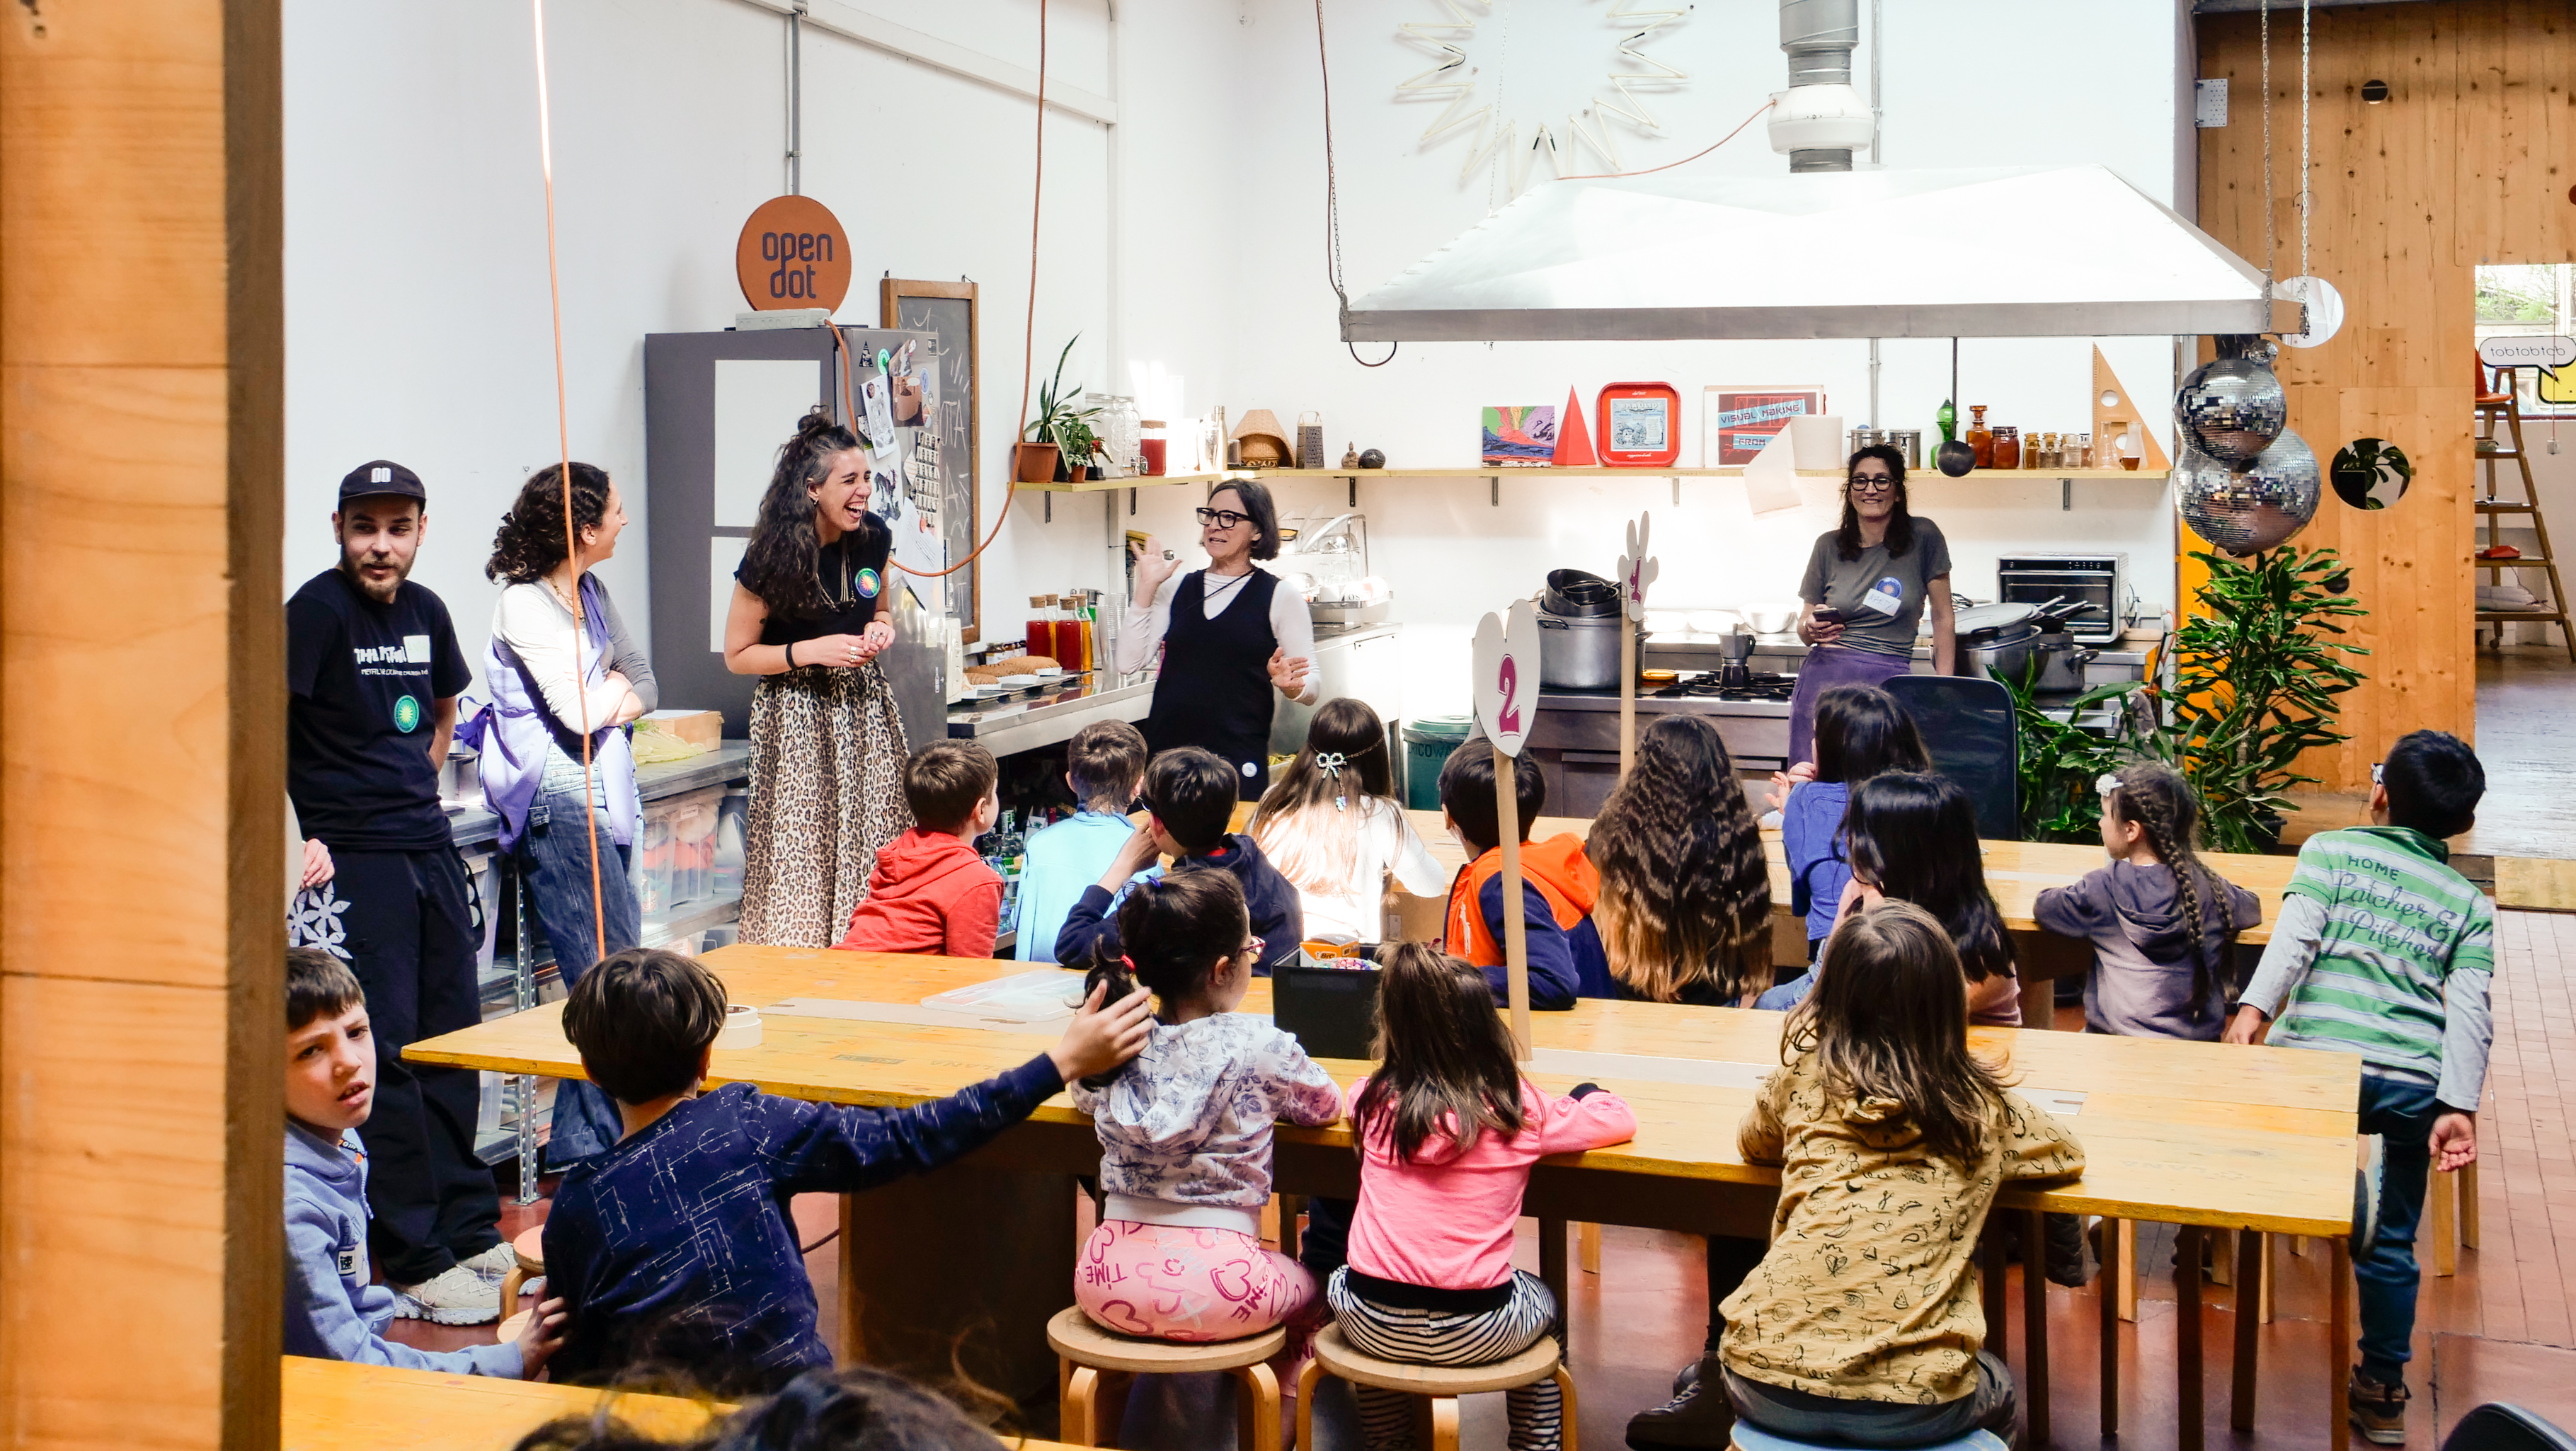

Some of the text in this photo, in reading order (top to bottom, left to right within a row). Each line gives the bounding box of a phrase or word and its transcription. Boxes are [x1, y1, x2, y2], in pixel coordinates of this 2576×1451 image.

[762, 231, 832, 273] open
[770, 264, 817, 299] dot
[1496, 653, 1521, 738] 2
[2348, 855, 2400, 881] HOME
[2335, 873, 2428, 920] Patcher
